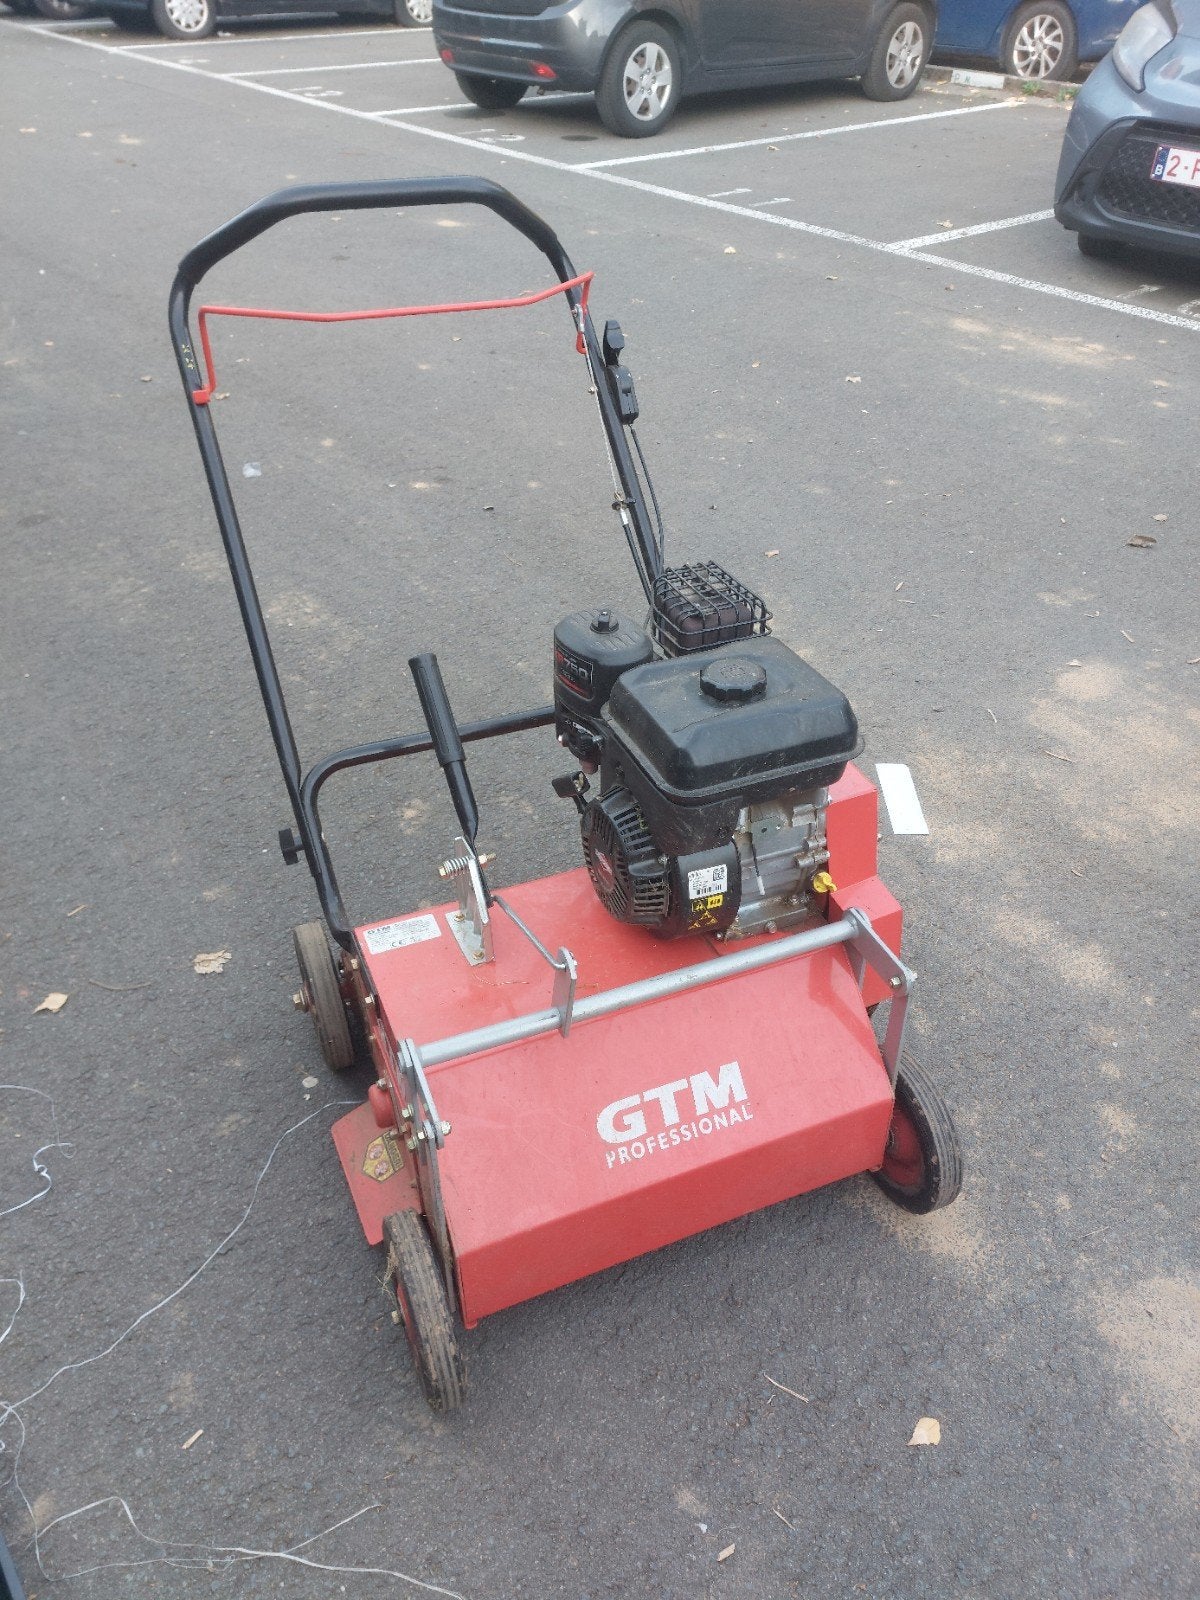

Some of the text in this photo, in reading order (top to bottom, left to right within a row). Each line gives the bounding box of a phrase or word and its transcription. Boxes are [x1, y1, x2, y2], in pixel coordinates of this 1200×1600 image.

[1154, 163, 1164, 176] B
[596, 1061, 748, 1144] GTM
[605, 1103, 754, 1169] PROFESSIONAL
